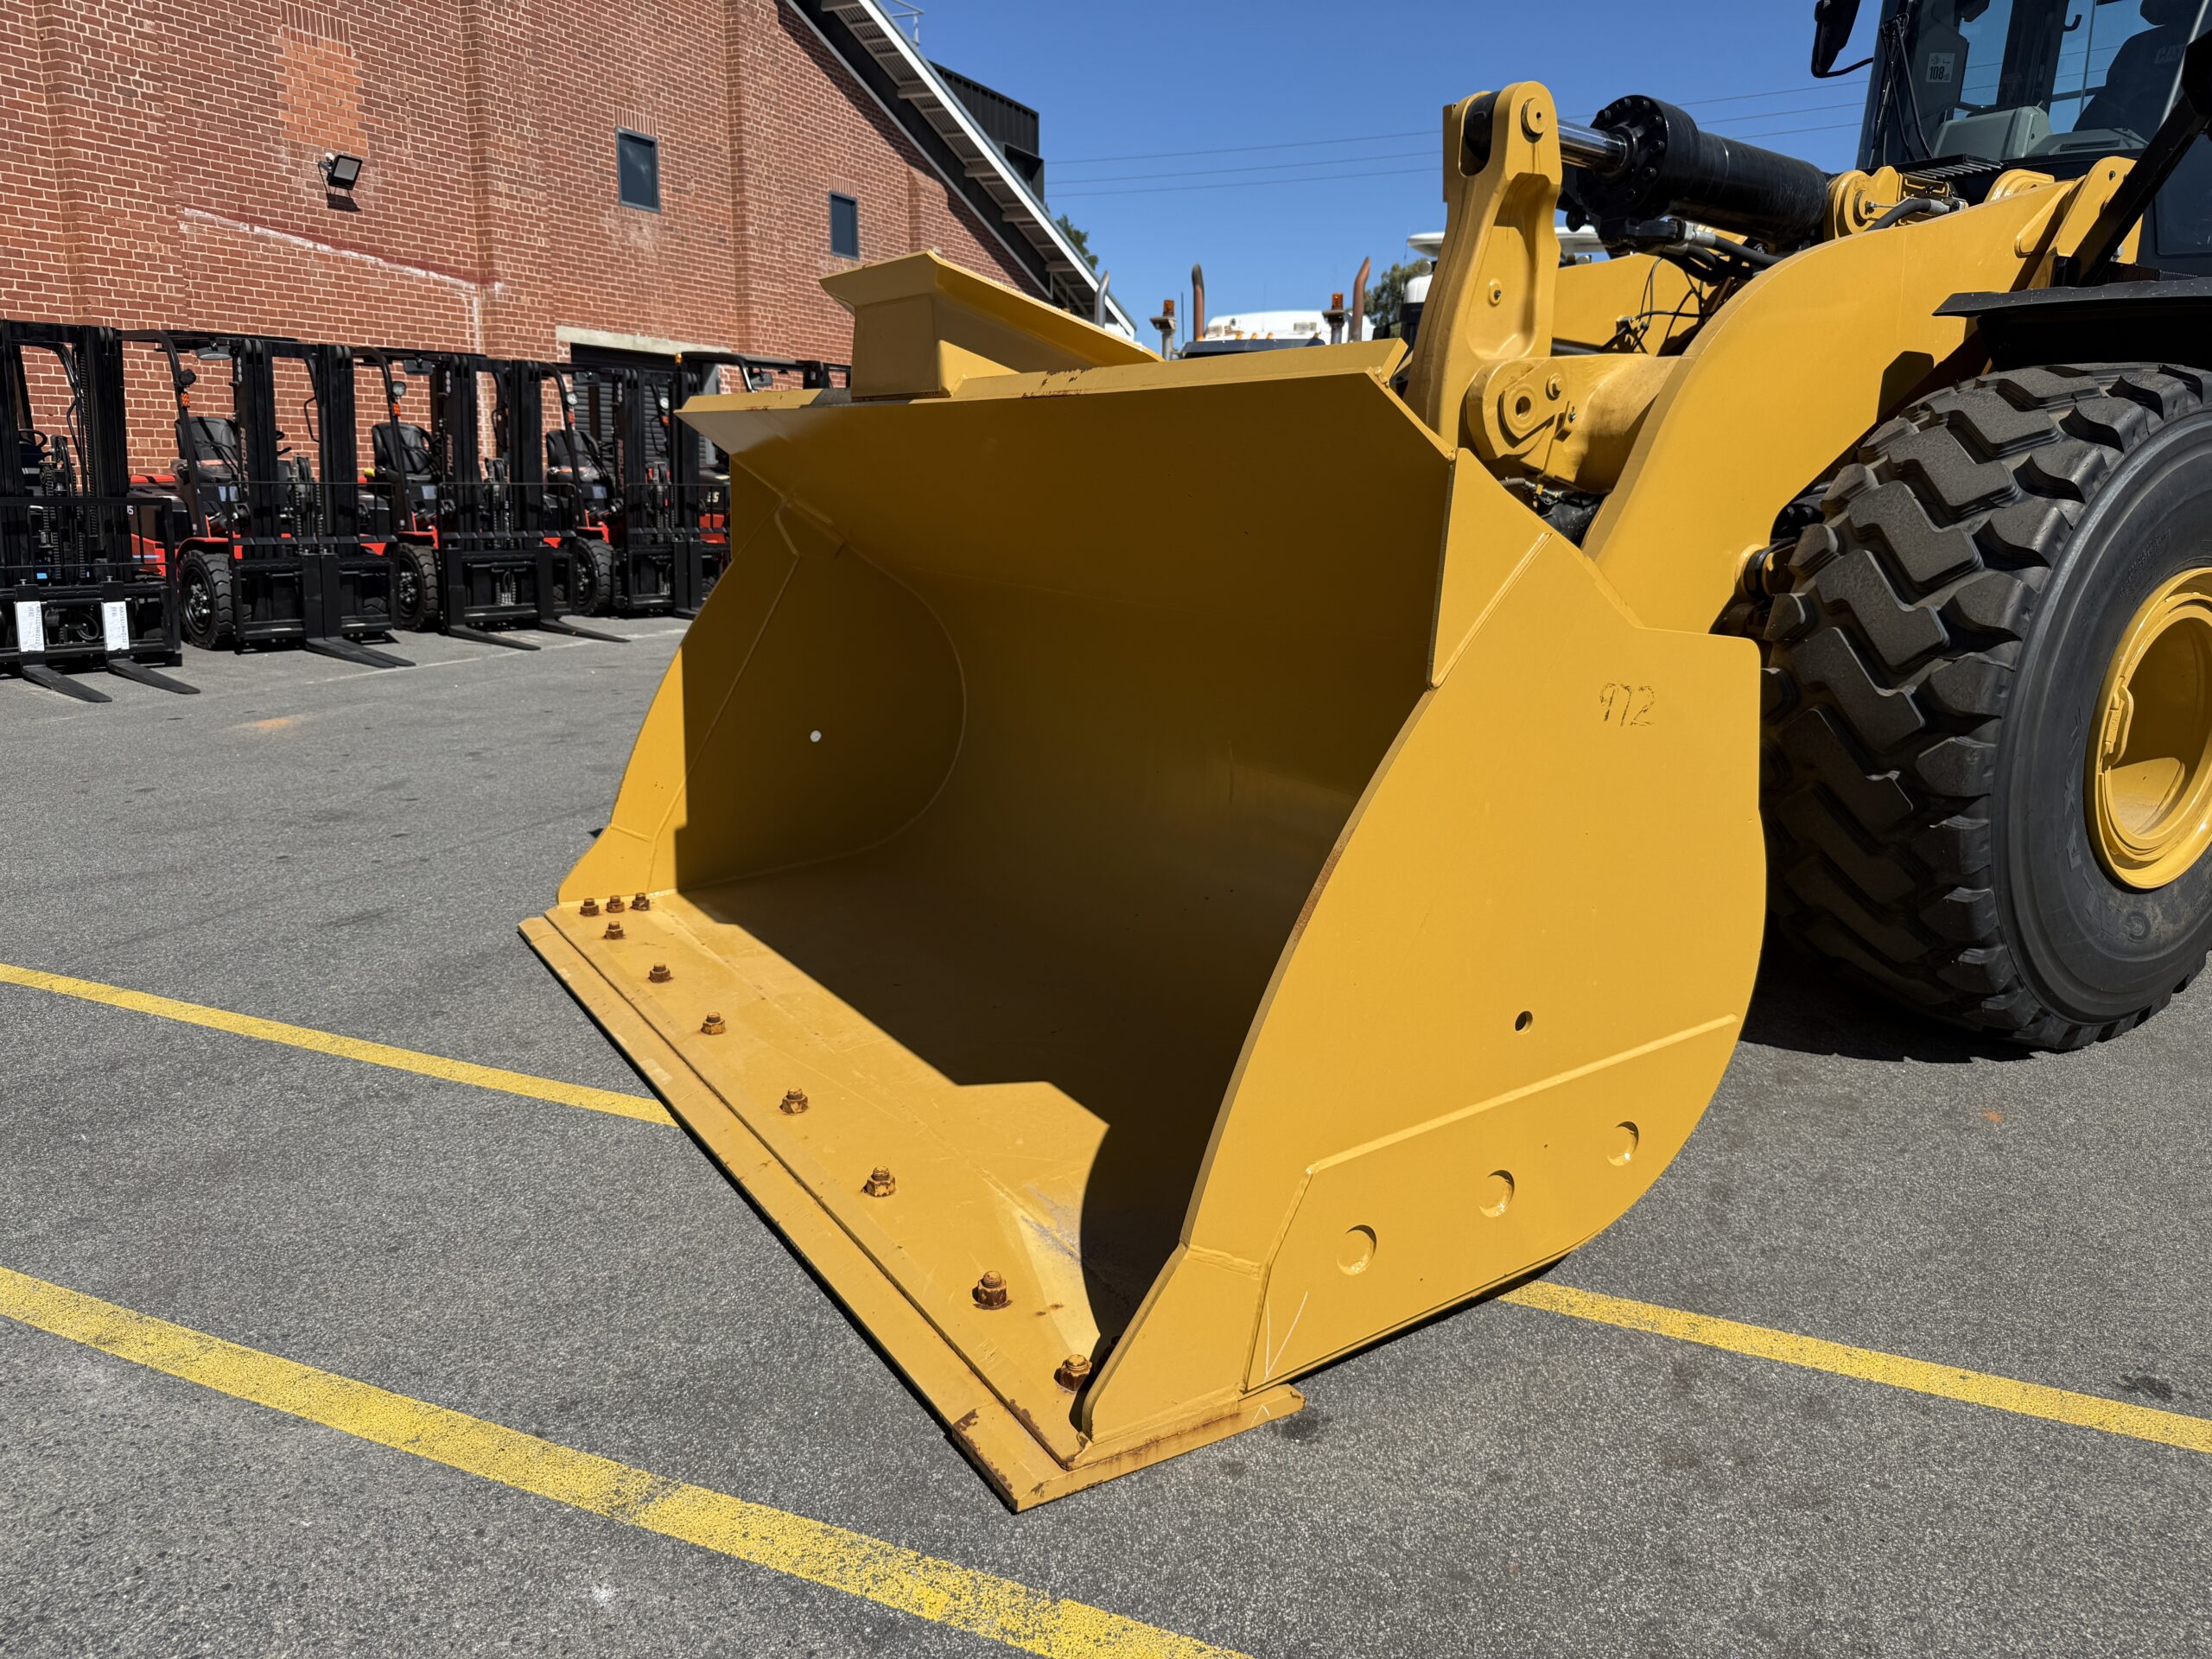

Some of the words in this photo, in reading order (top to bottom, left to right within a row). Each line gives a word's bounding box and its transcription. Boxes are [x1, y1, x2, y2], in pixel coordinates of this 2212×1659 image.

[2153, 43, 2185, 64] CAT
[1929, 66, 1945, 80] 108
[239, 427, 250, 496] REDLIFT
[1599, 683, 1655, 726] 972
